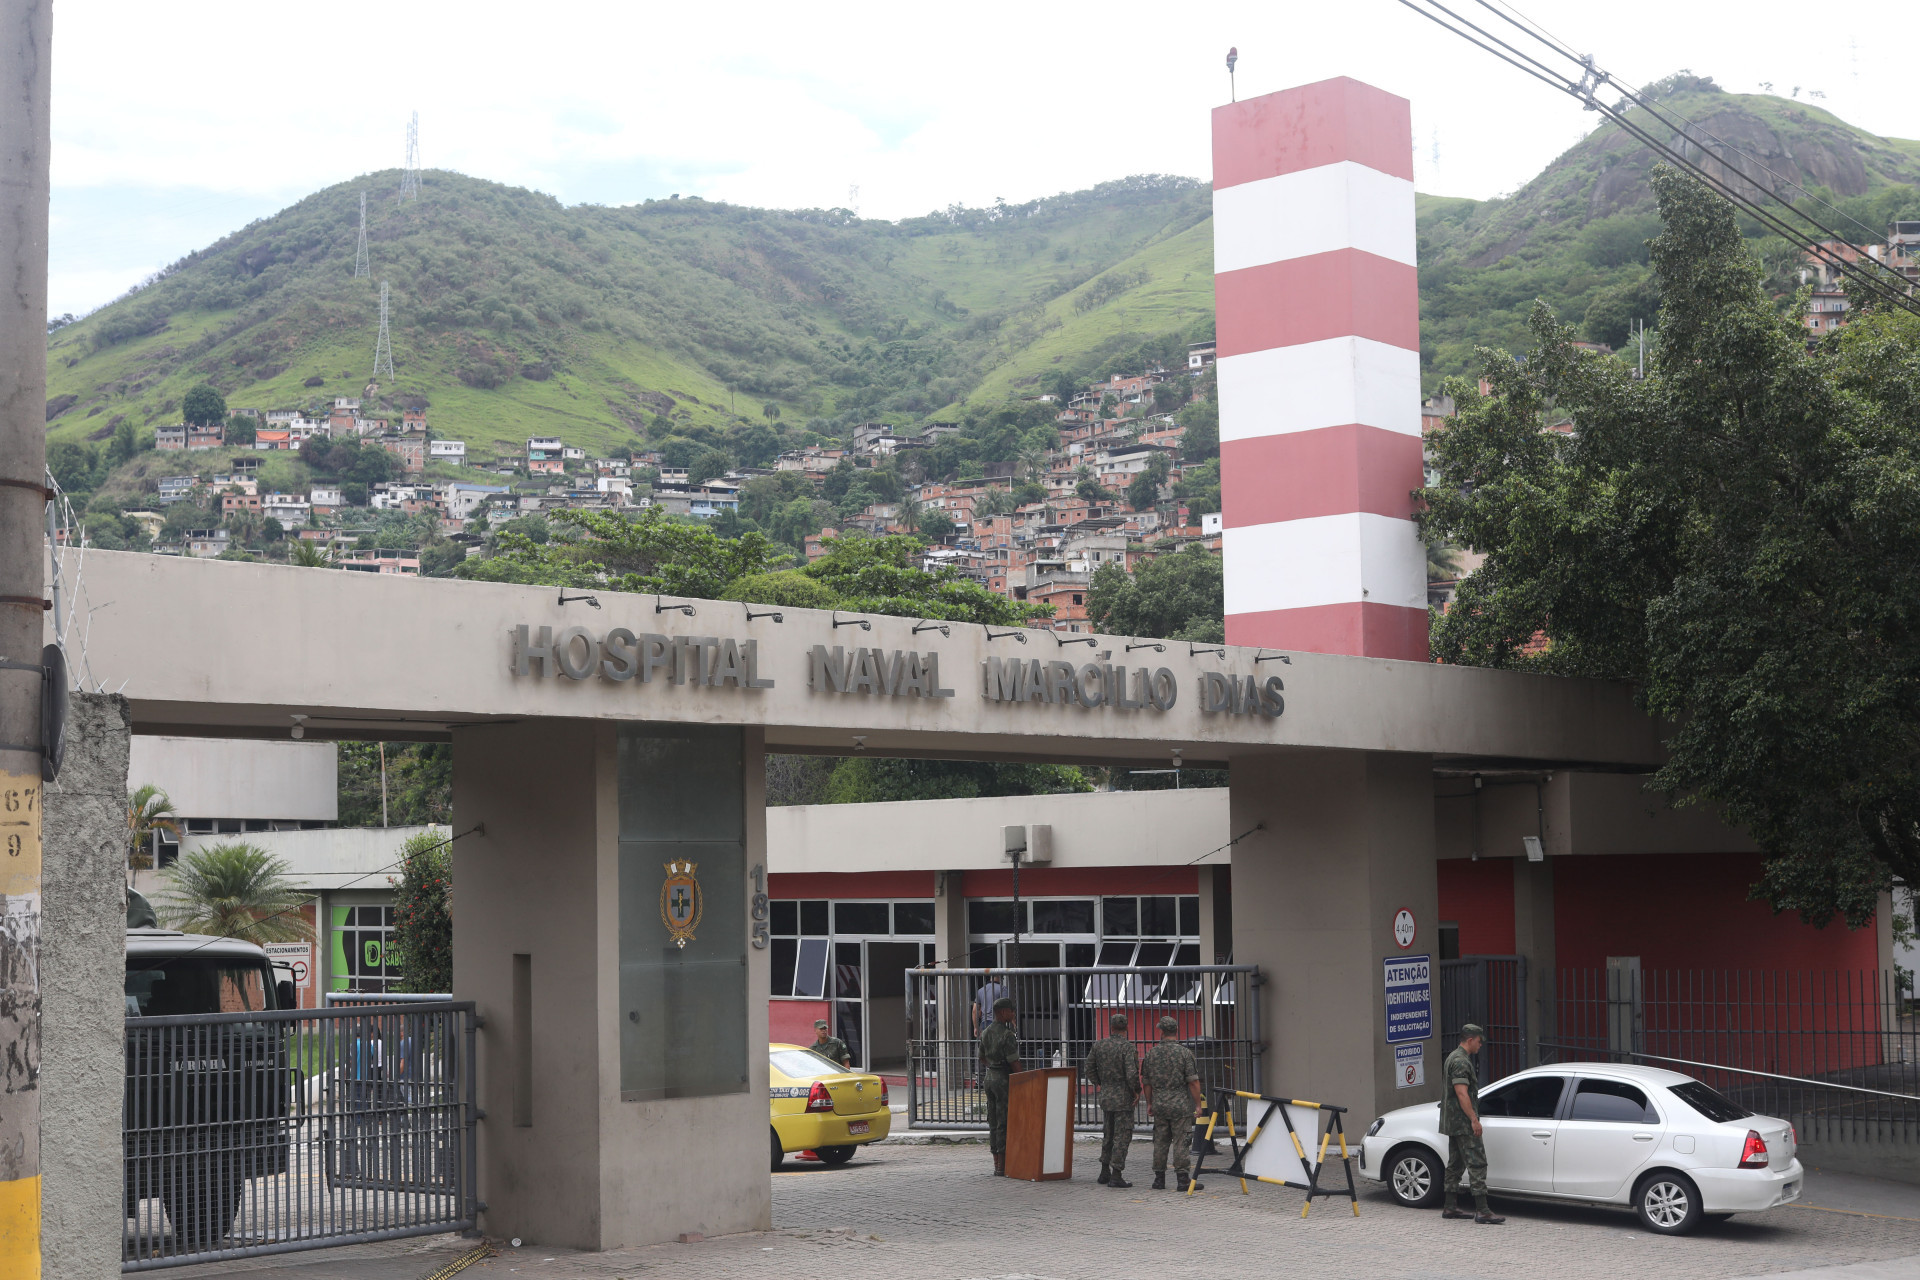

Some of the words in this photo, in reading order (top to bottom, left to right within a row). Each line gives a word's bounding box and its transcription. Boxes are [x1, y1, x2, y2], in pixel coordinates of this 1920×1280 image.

[515, 624, 775, 689] HOSPITAL
[812, 644, 955, 697] NAVAL
[986, 650, 1177, 711] MARCÍLIO
[1202, 671, 1285, 717] DIAS
[4, 788, 36, 812] 67
[8, 833, 21, 857] 9
[750, 863, 769, 949] 185
[265, 946, 309, 954] ESTACIONAMENTOS
[1387, 964, 1428, 984] ATENÇÃO
[1387, 989, 1430, 1006] IDENTIFIQUE-SE
[1390, 1009, 1428, 1021] INDEPENDENTE
[1389, 1025, 1397, 1033] DE
[1397, 1020, 1430, 1033] SOLICITAÇÃO
[1397, 1046, 1421, 1057] PROIBIDO
